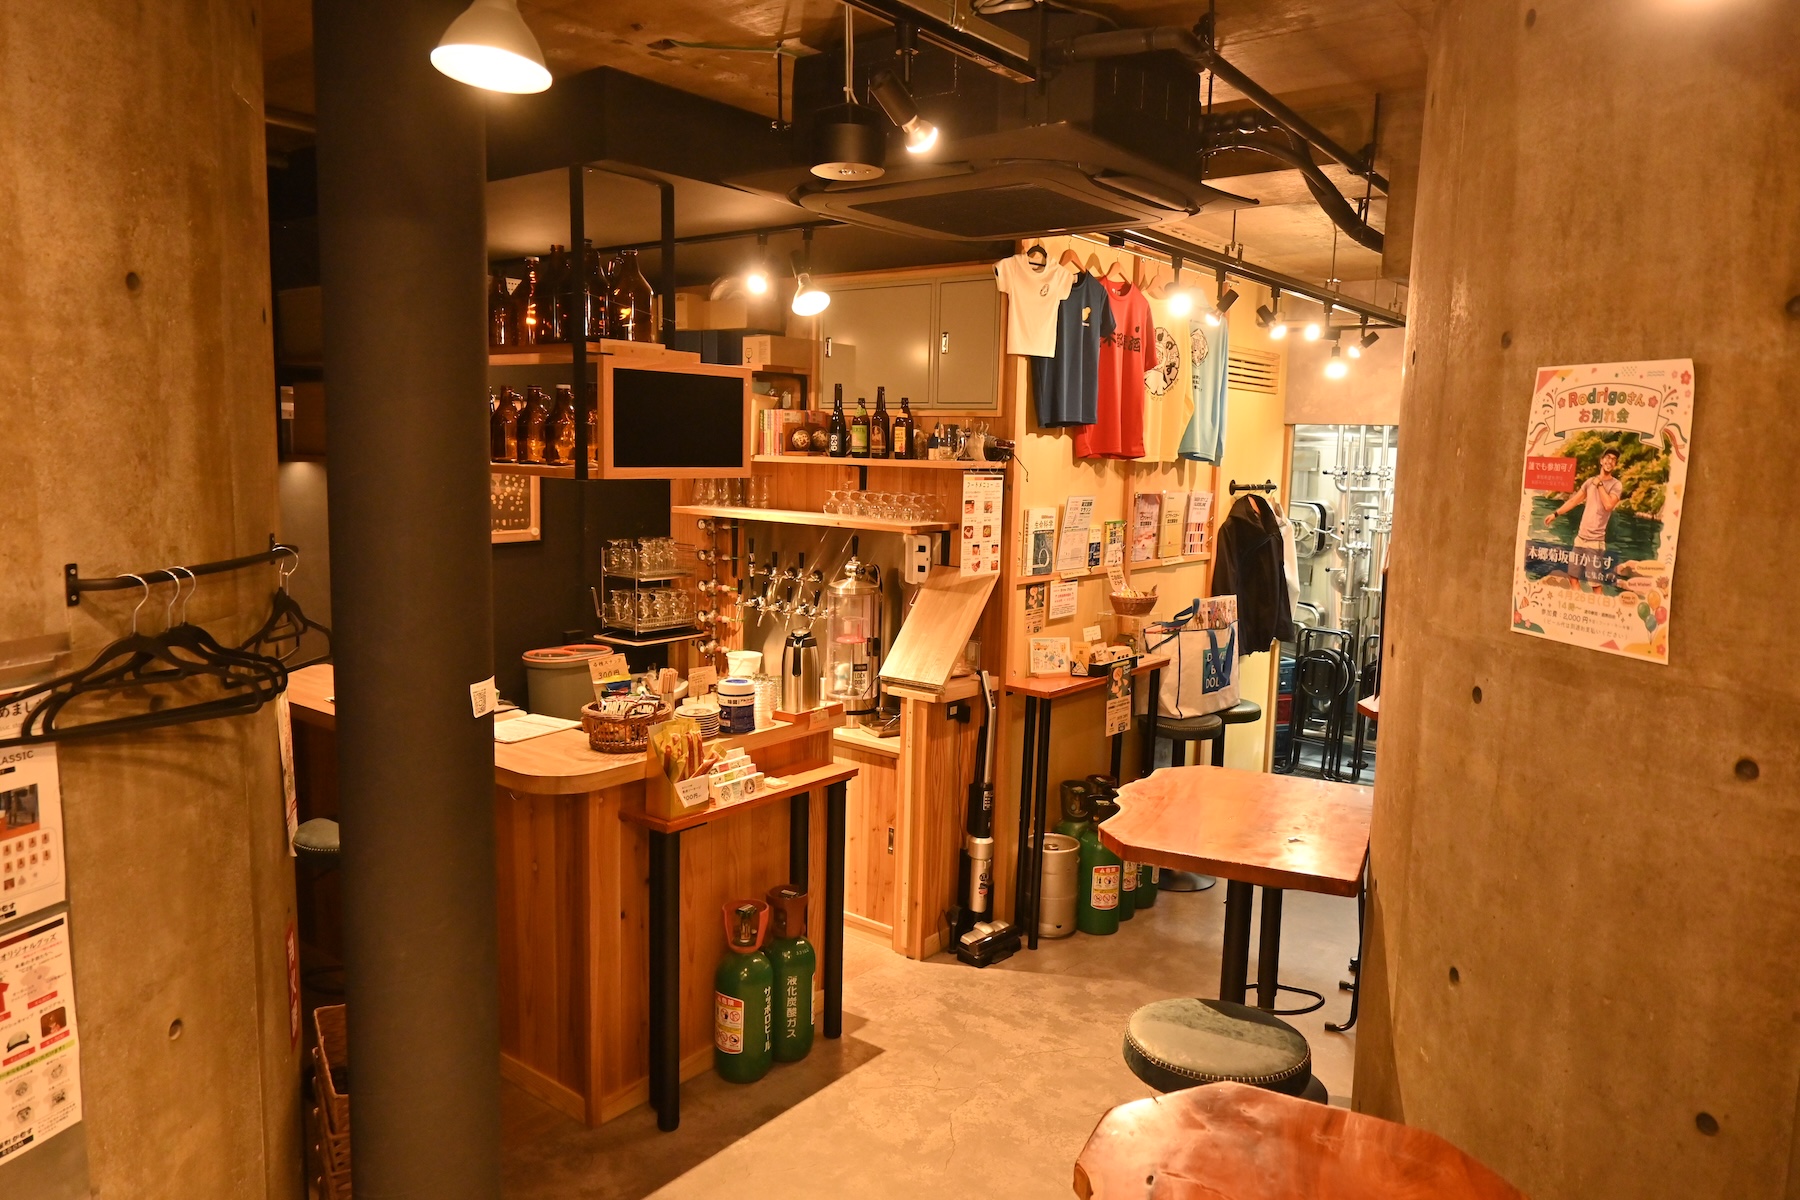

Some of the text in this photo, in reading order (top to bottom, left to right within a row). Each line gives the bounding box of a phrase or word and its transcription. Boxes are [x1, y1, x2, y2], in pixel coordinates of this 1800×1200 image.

[1568, 387, 1646, 408] Rodrigoさん
[1579, 407, 1630, 423] お別れ会
[830, 434, 838, 452] 639
[1527, 546, 1614, 570] 本郷菊坂町かもす
[0, 699, 42, 718] めまし
[0, 750, 34, 766] ASSIC
[786, 975, 798, 1038] 液化炭酸ガス
[763, 985, 772, 1053] サッポロビール
